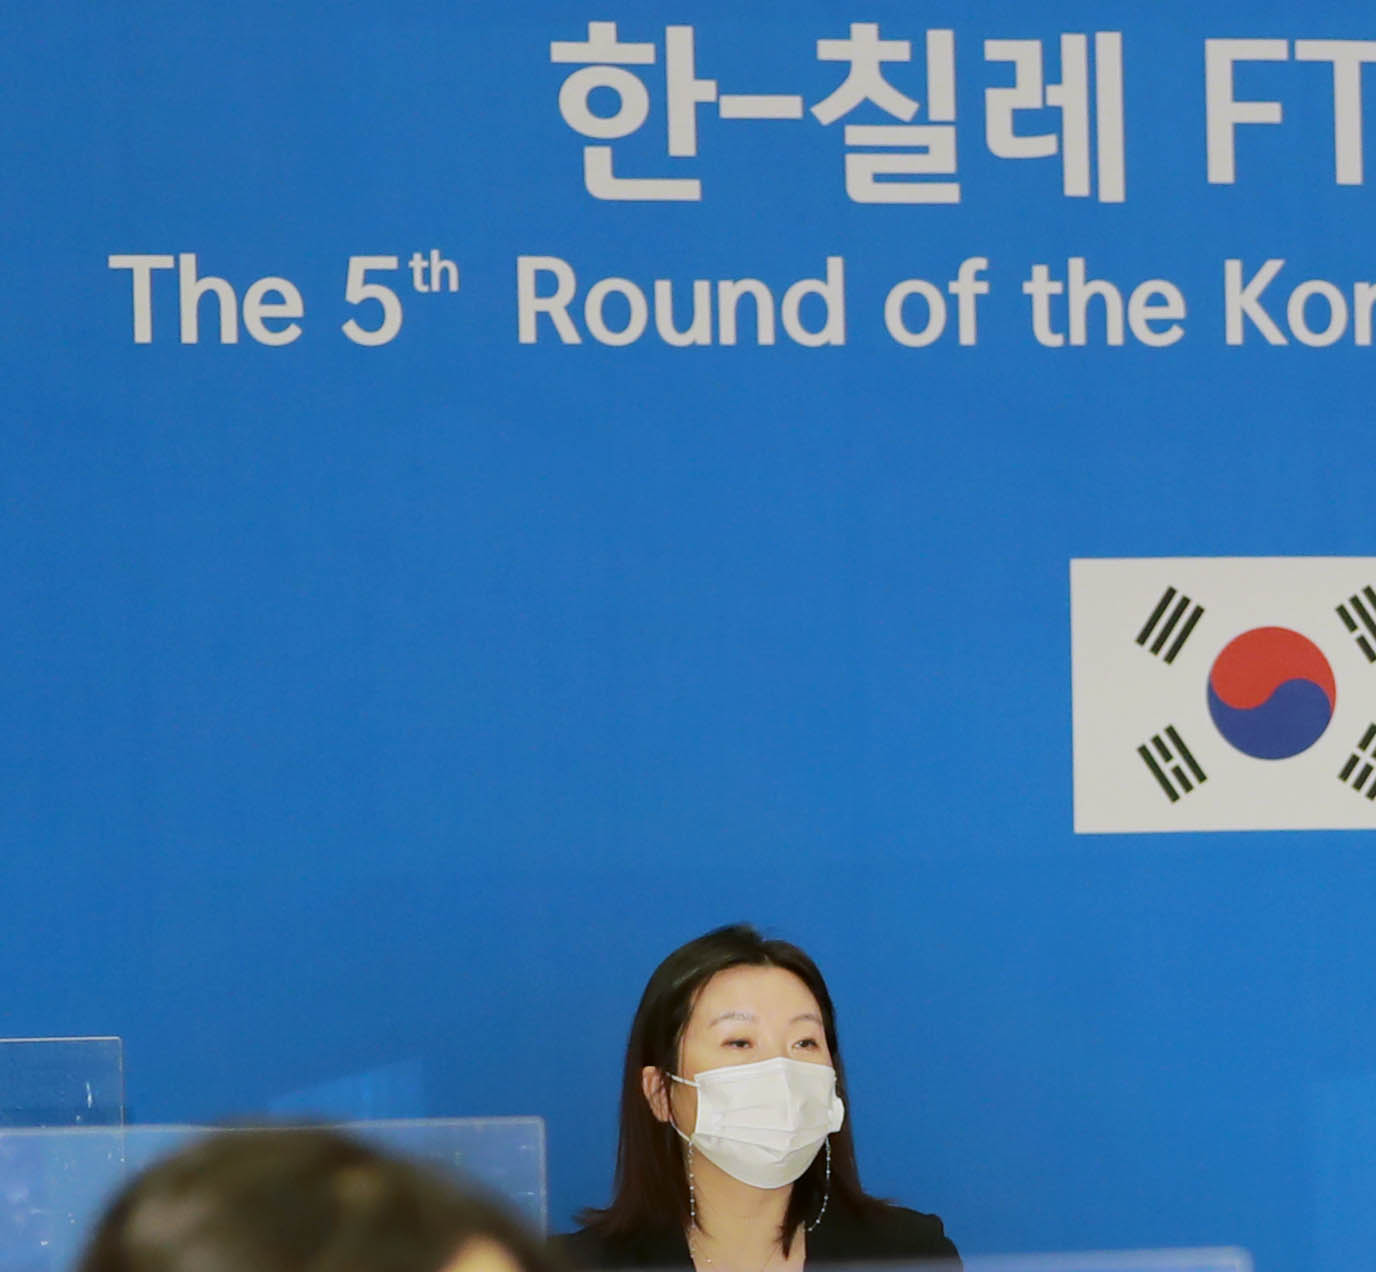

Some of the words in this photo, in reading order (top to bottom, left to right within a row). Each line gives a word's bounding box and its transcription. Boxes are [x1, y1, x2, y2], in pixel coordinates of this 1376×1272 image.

[551, 22, 1125, 203] 한-칠레
[109, 253, 304, 345] The
[342, 250, 458, 346] 5th
[517, 256, 845, 347] Round
[885, 257, 989, 347] of
[1023, 257, 1186, 347] the
